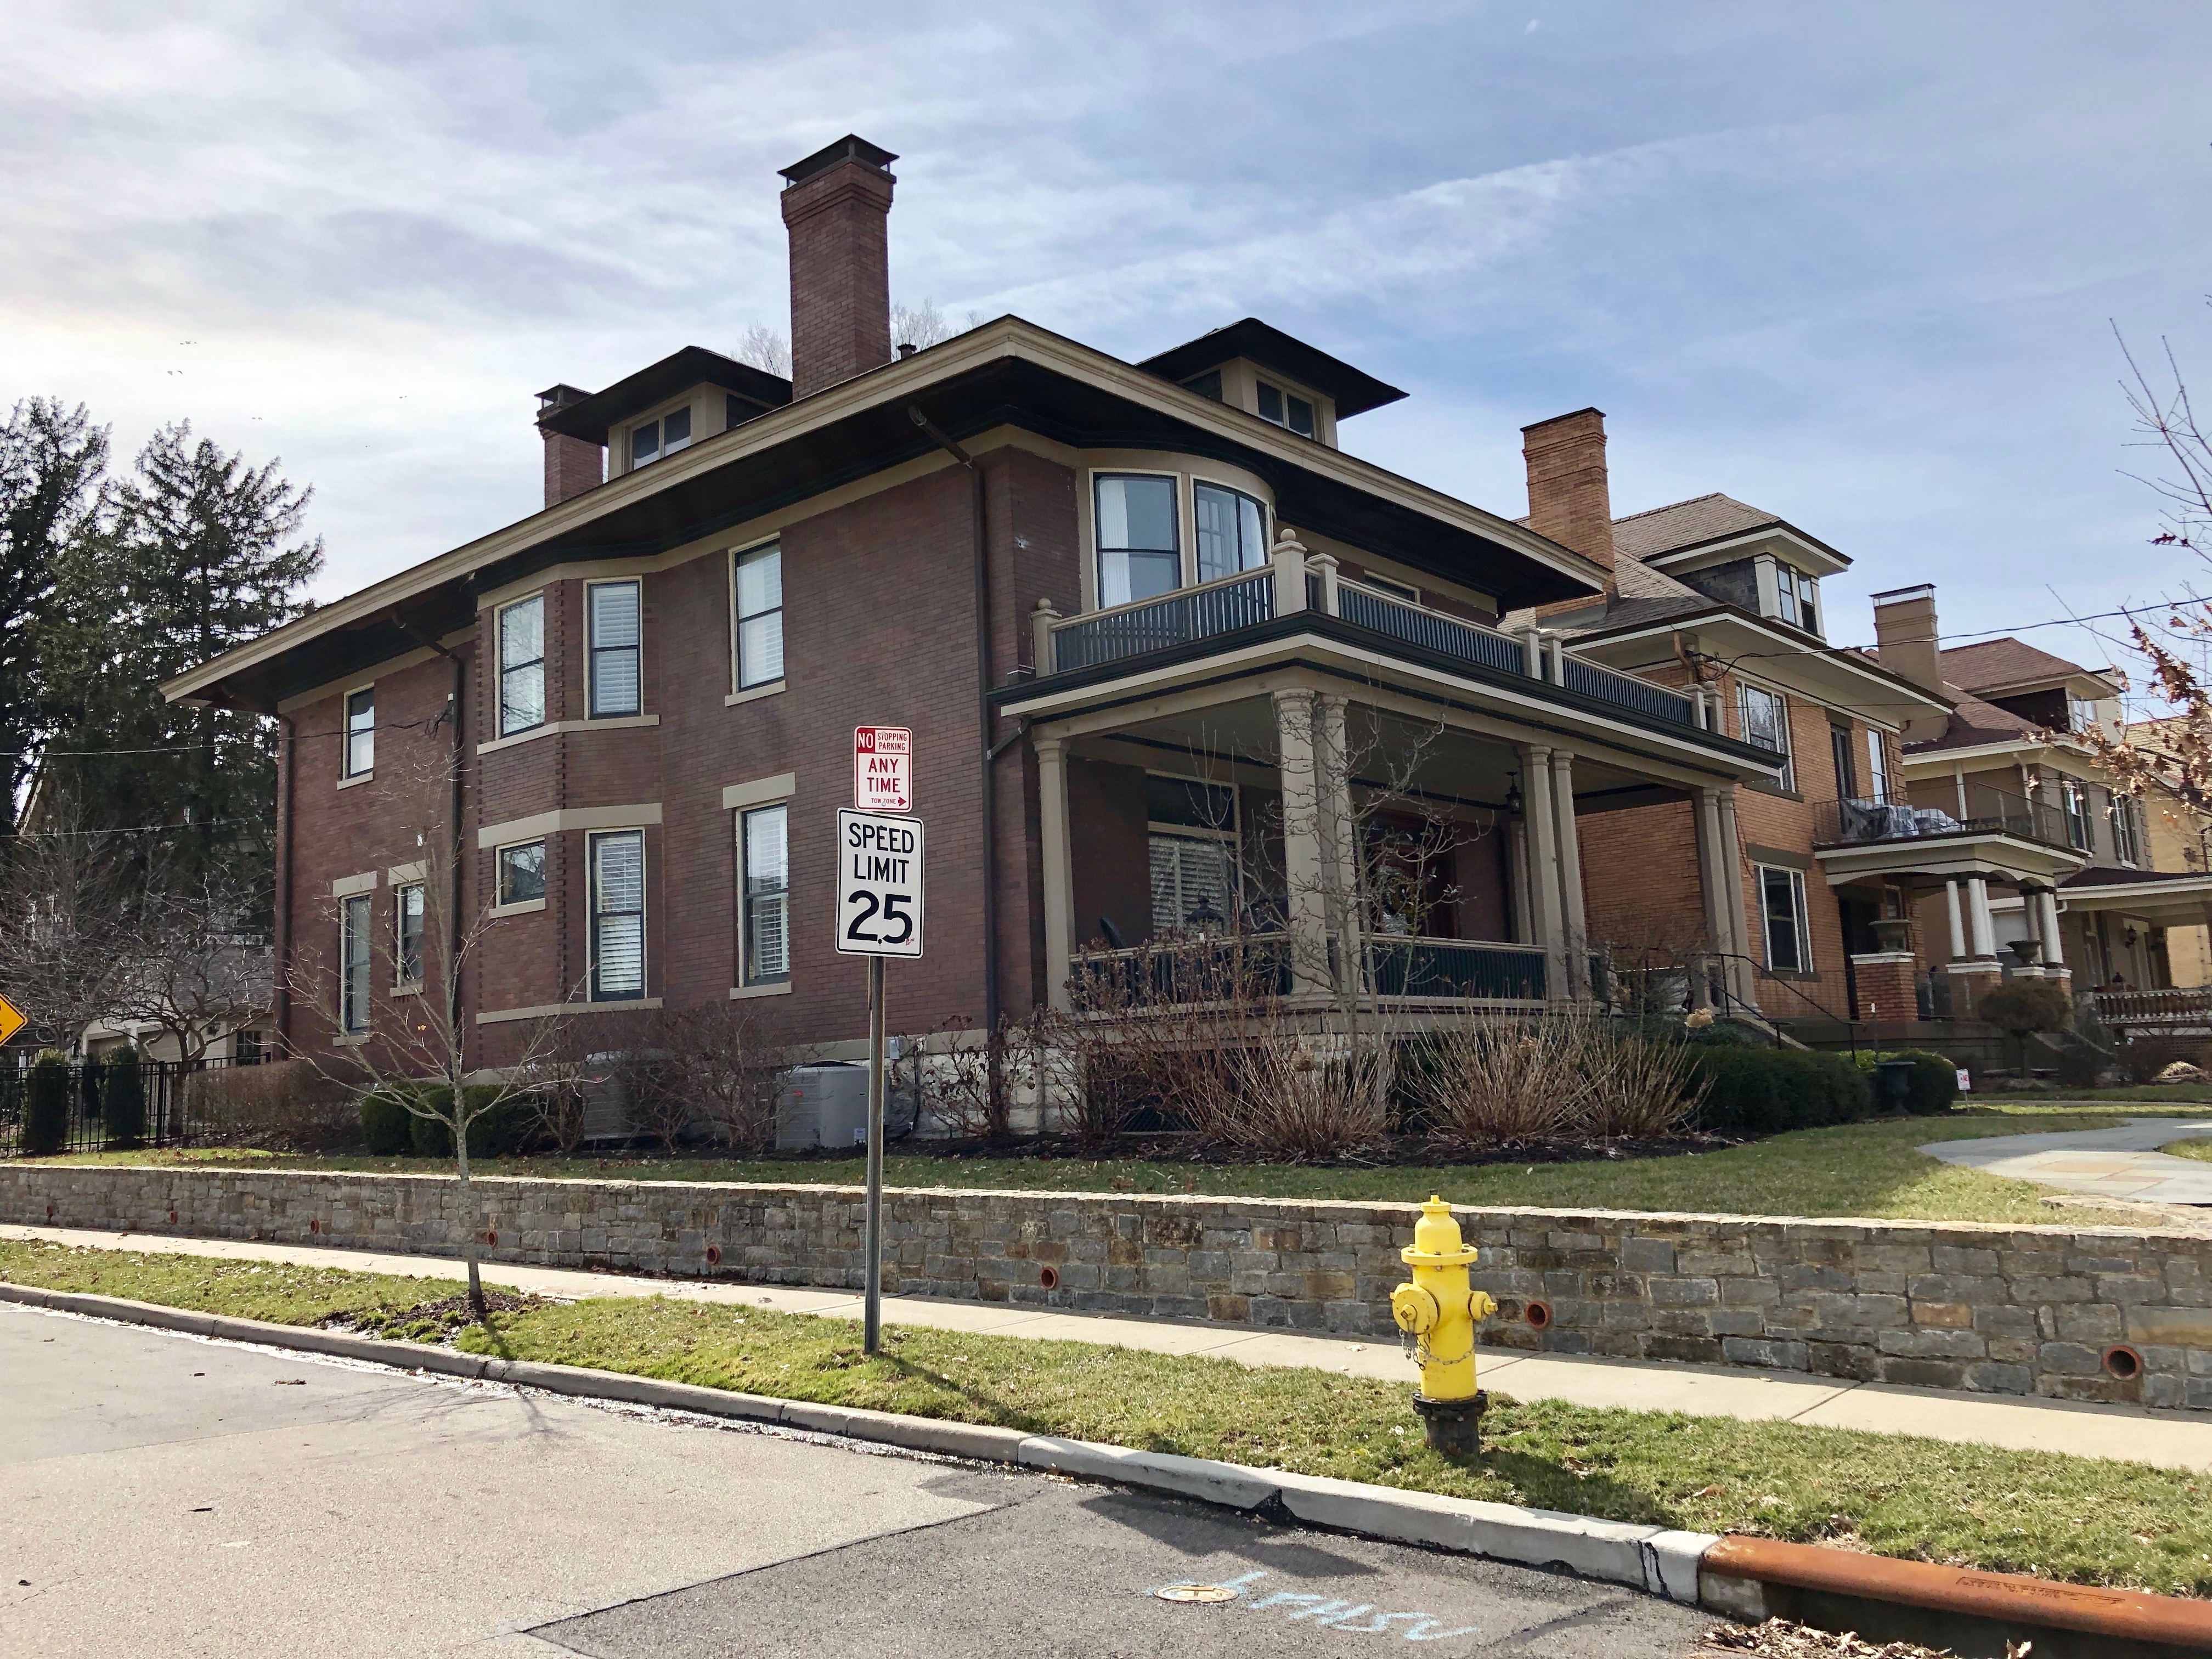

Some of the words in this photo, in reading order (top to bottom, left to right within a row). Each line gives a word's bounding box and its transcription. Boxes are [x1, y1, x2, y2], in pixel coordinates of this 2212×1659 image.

[857, 732, 874, 749] NO
[877, 732, 907, 741] STOPPING
[879, 742, 906, 751] PARKING
[868, 758, 899, 774] ANY
[867, 777, 901, 793] TIME
[849, 822, 914, 854] SPEED
[854, 854, 910, 884] LIMIT
[847, 890, 913, 944] 25
